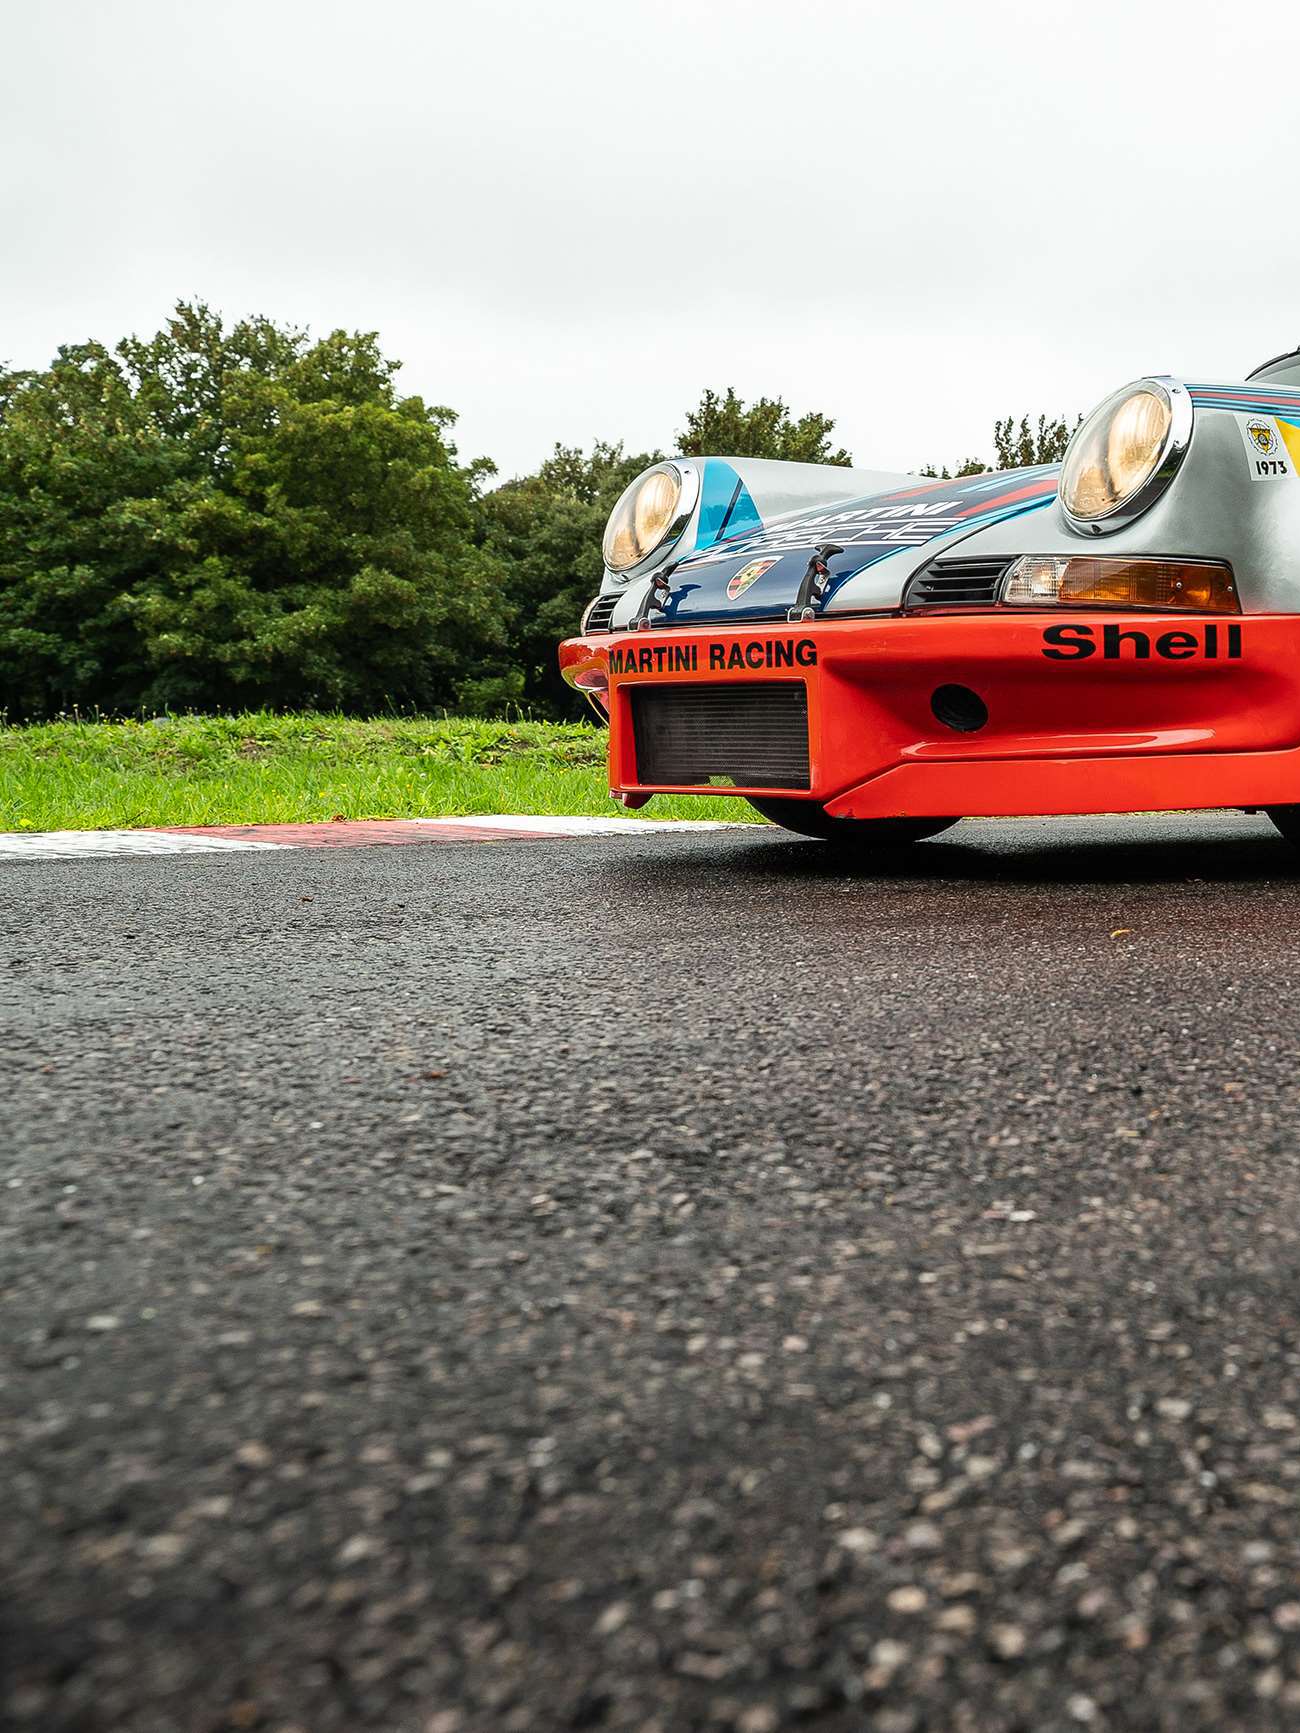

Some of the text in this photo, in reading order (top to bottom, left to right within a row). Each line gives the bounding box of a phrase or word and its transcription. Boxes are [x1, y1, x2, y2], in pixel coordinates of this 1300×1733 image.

[1256, 460, 1288, 475] 1973
[752, 500, 964, 537] MARTINI
[609, 638, 818, 675] MARTINI RACING
[1041, 623, 1242, 661] Shell
